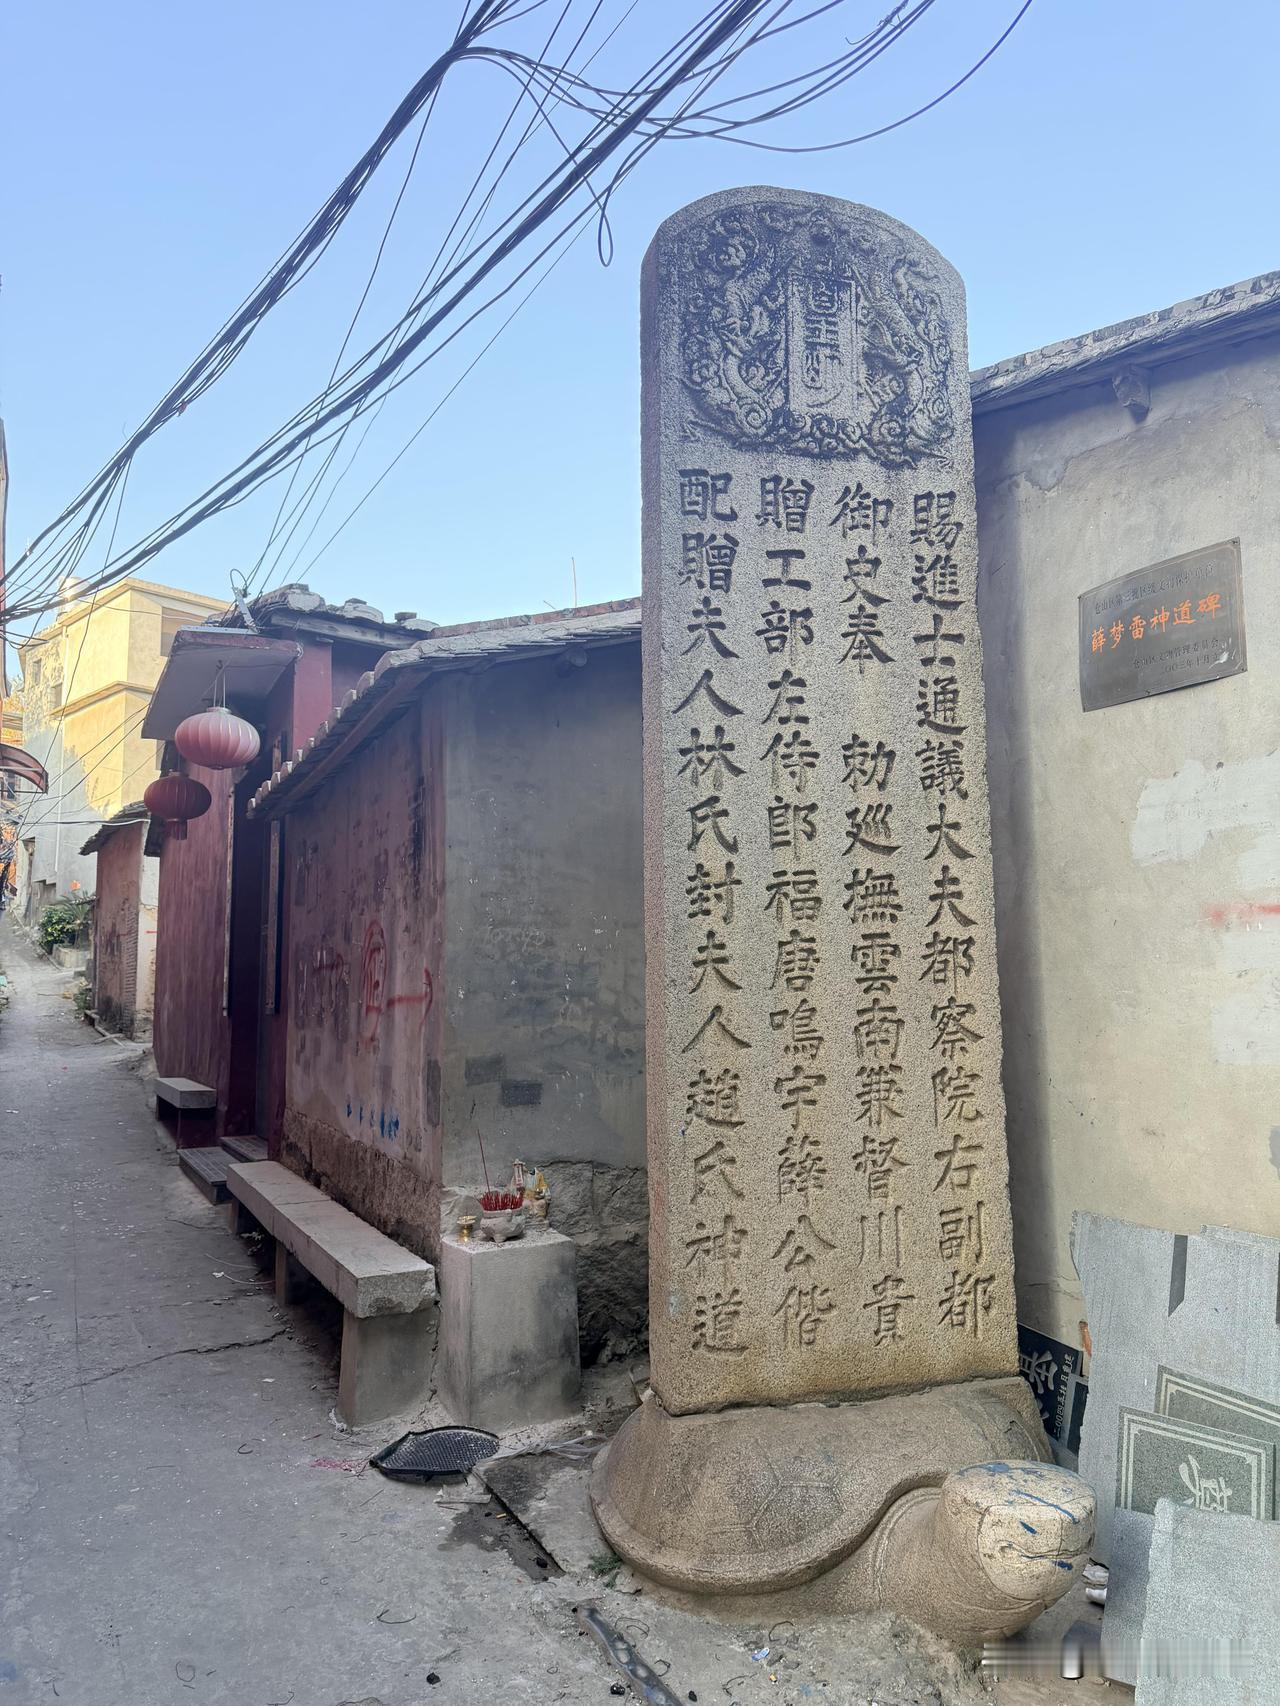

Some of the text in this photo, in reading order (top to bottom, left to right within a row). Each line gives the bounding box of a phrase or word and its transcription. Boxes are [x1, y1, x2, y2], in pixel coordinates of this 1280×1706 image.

[1091, 592, 1222, 655] 薛梦雷神道碑
